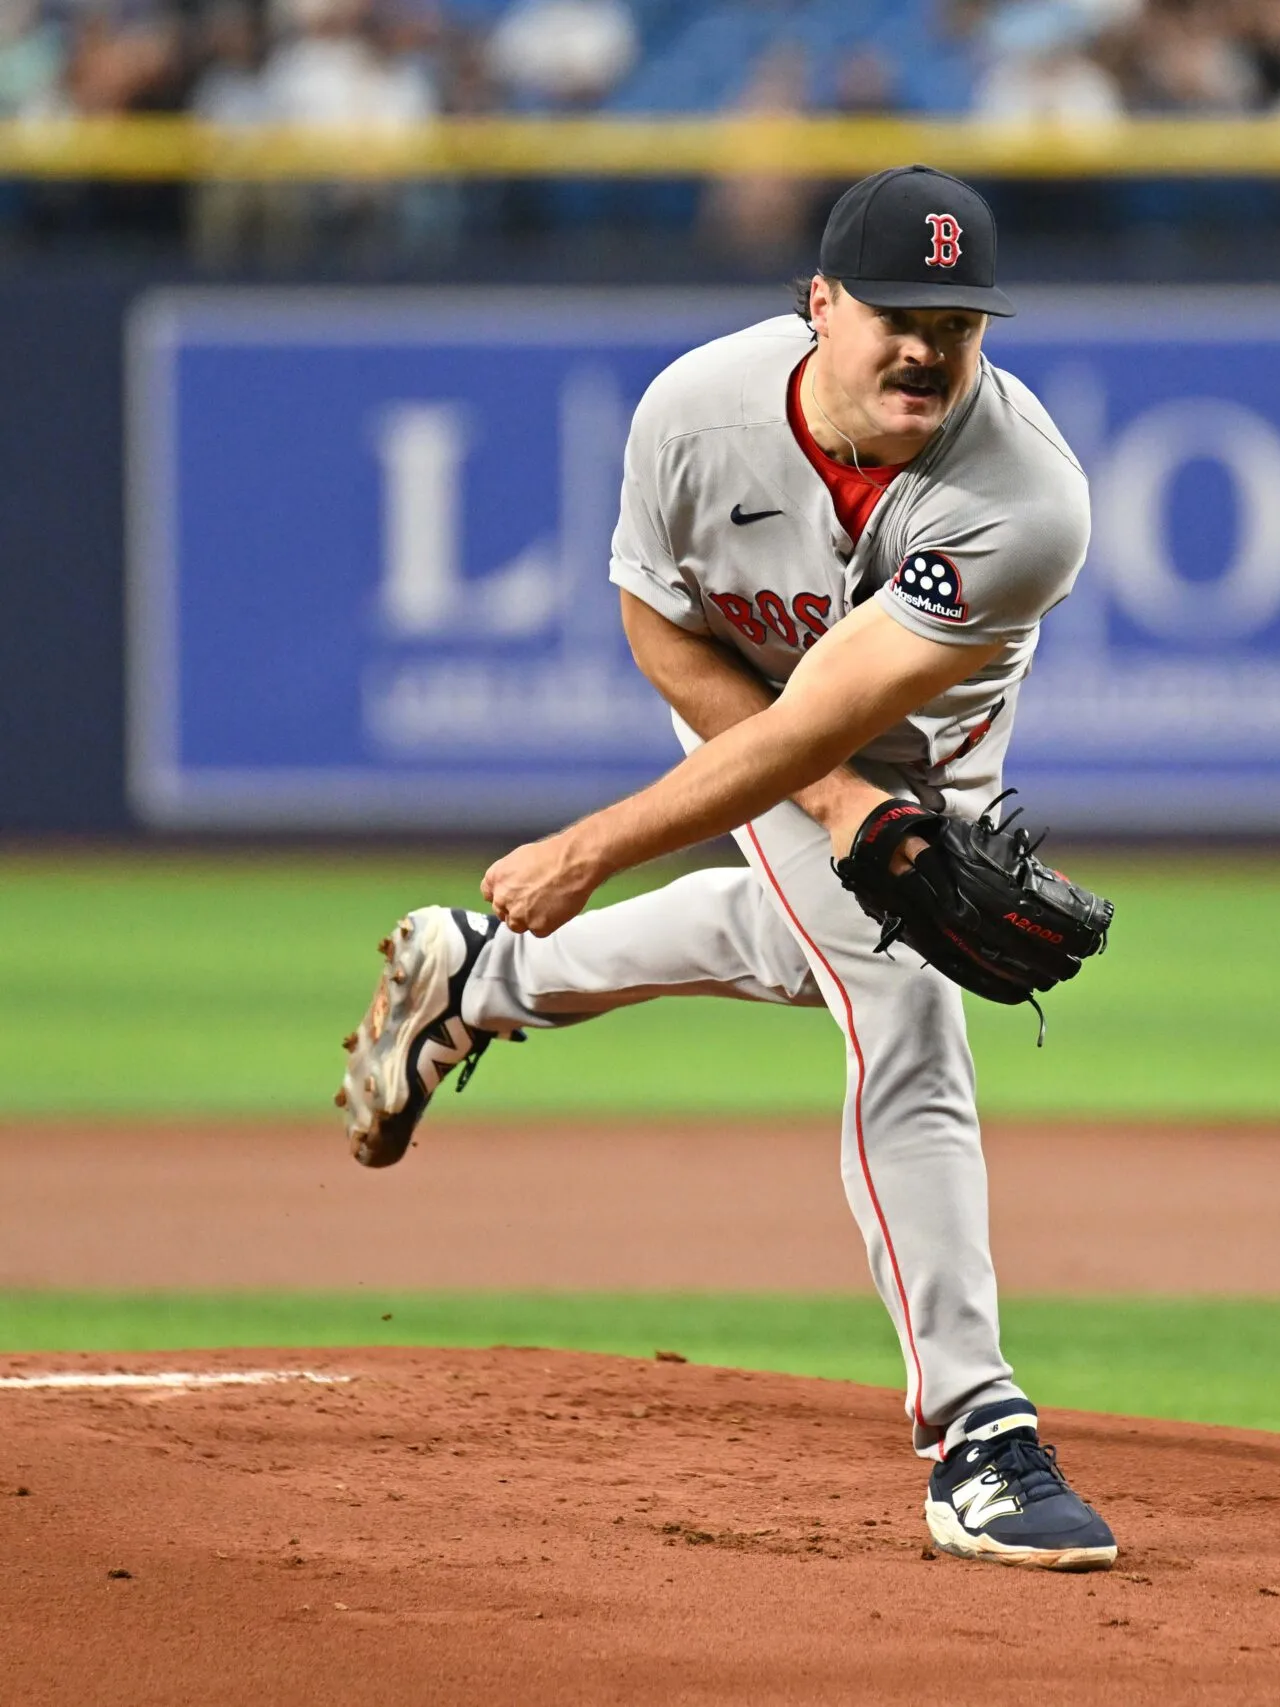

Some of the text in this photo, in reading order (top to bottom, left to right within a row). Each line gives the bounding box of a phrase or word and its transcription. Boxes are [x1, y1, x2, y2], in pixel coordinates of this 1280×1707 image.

[925, 213, 963, 268] B
[894, 584, 963, 618] MassMutual
[1002, 911, 1064, 945] A2000
